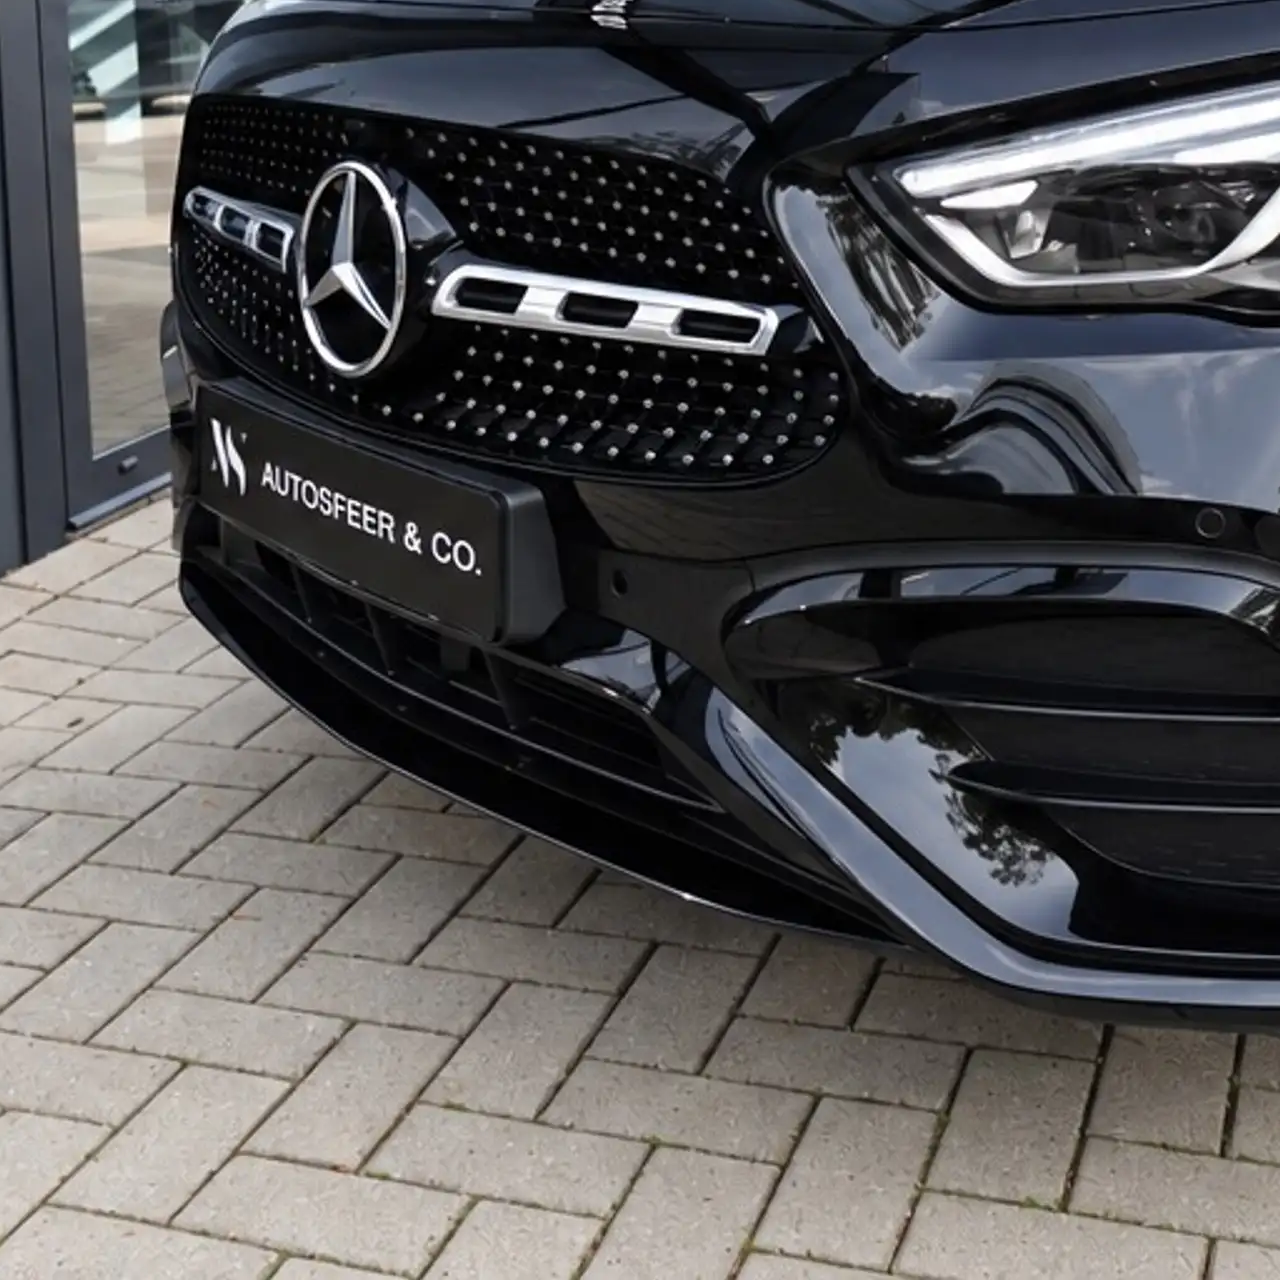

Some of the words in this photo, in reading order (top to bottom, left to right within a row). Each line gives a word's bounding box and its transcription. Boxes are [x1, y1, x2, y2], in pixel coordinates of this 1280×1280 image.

[261, 462, 396, 544] AUTOSFEER
[403, 521, 423, 555] &
[431, 531, 483, 577] CO.
